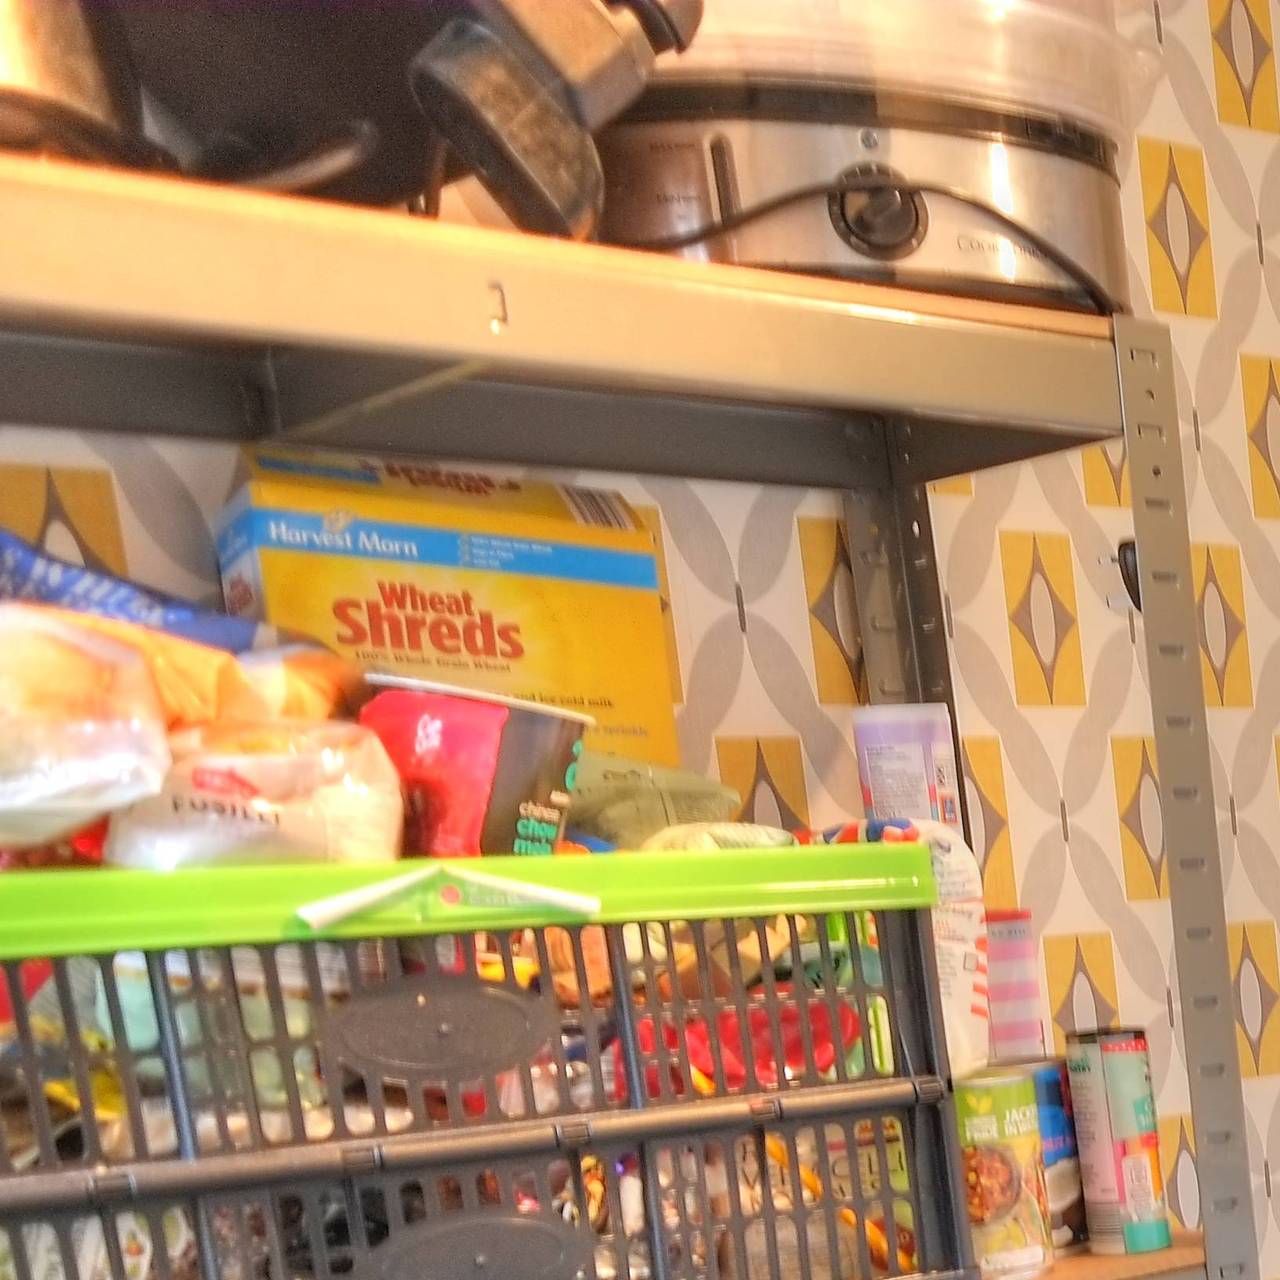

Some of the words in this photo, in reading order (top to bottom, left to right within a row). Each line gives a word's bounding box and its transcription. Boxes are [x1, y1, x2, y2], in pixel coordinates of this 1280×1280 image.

[268, 521, 351, 548] Harvest
[358, 530, 419, 558] Morn
[377, 580, 475, 617] Wheat
[331, 596, 525, 660] Shreds
